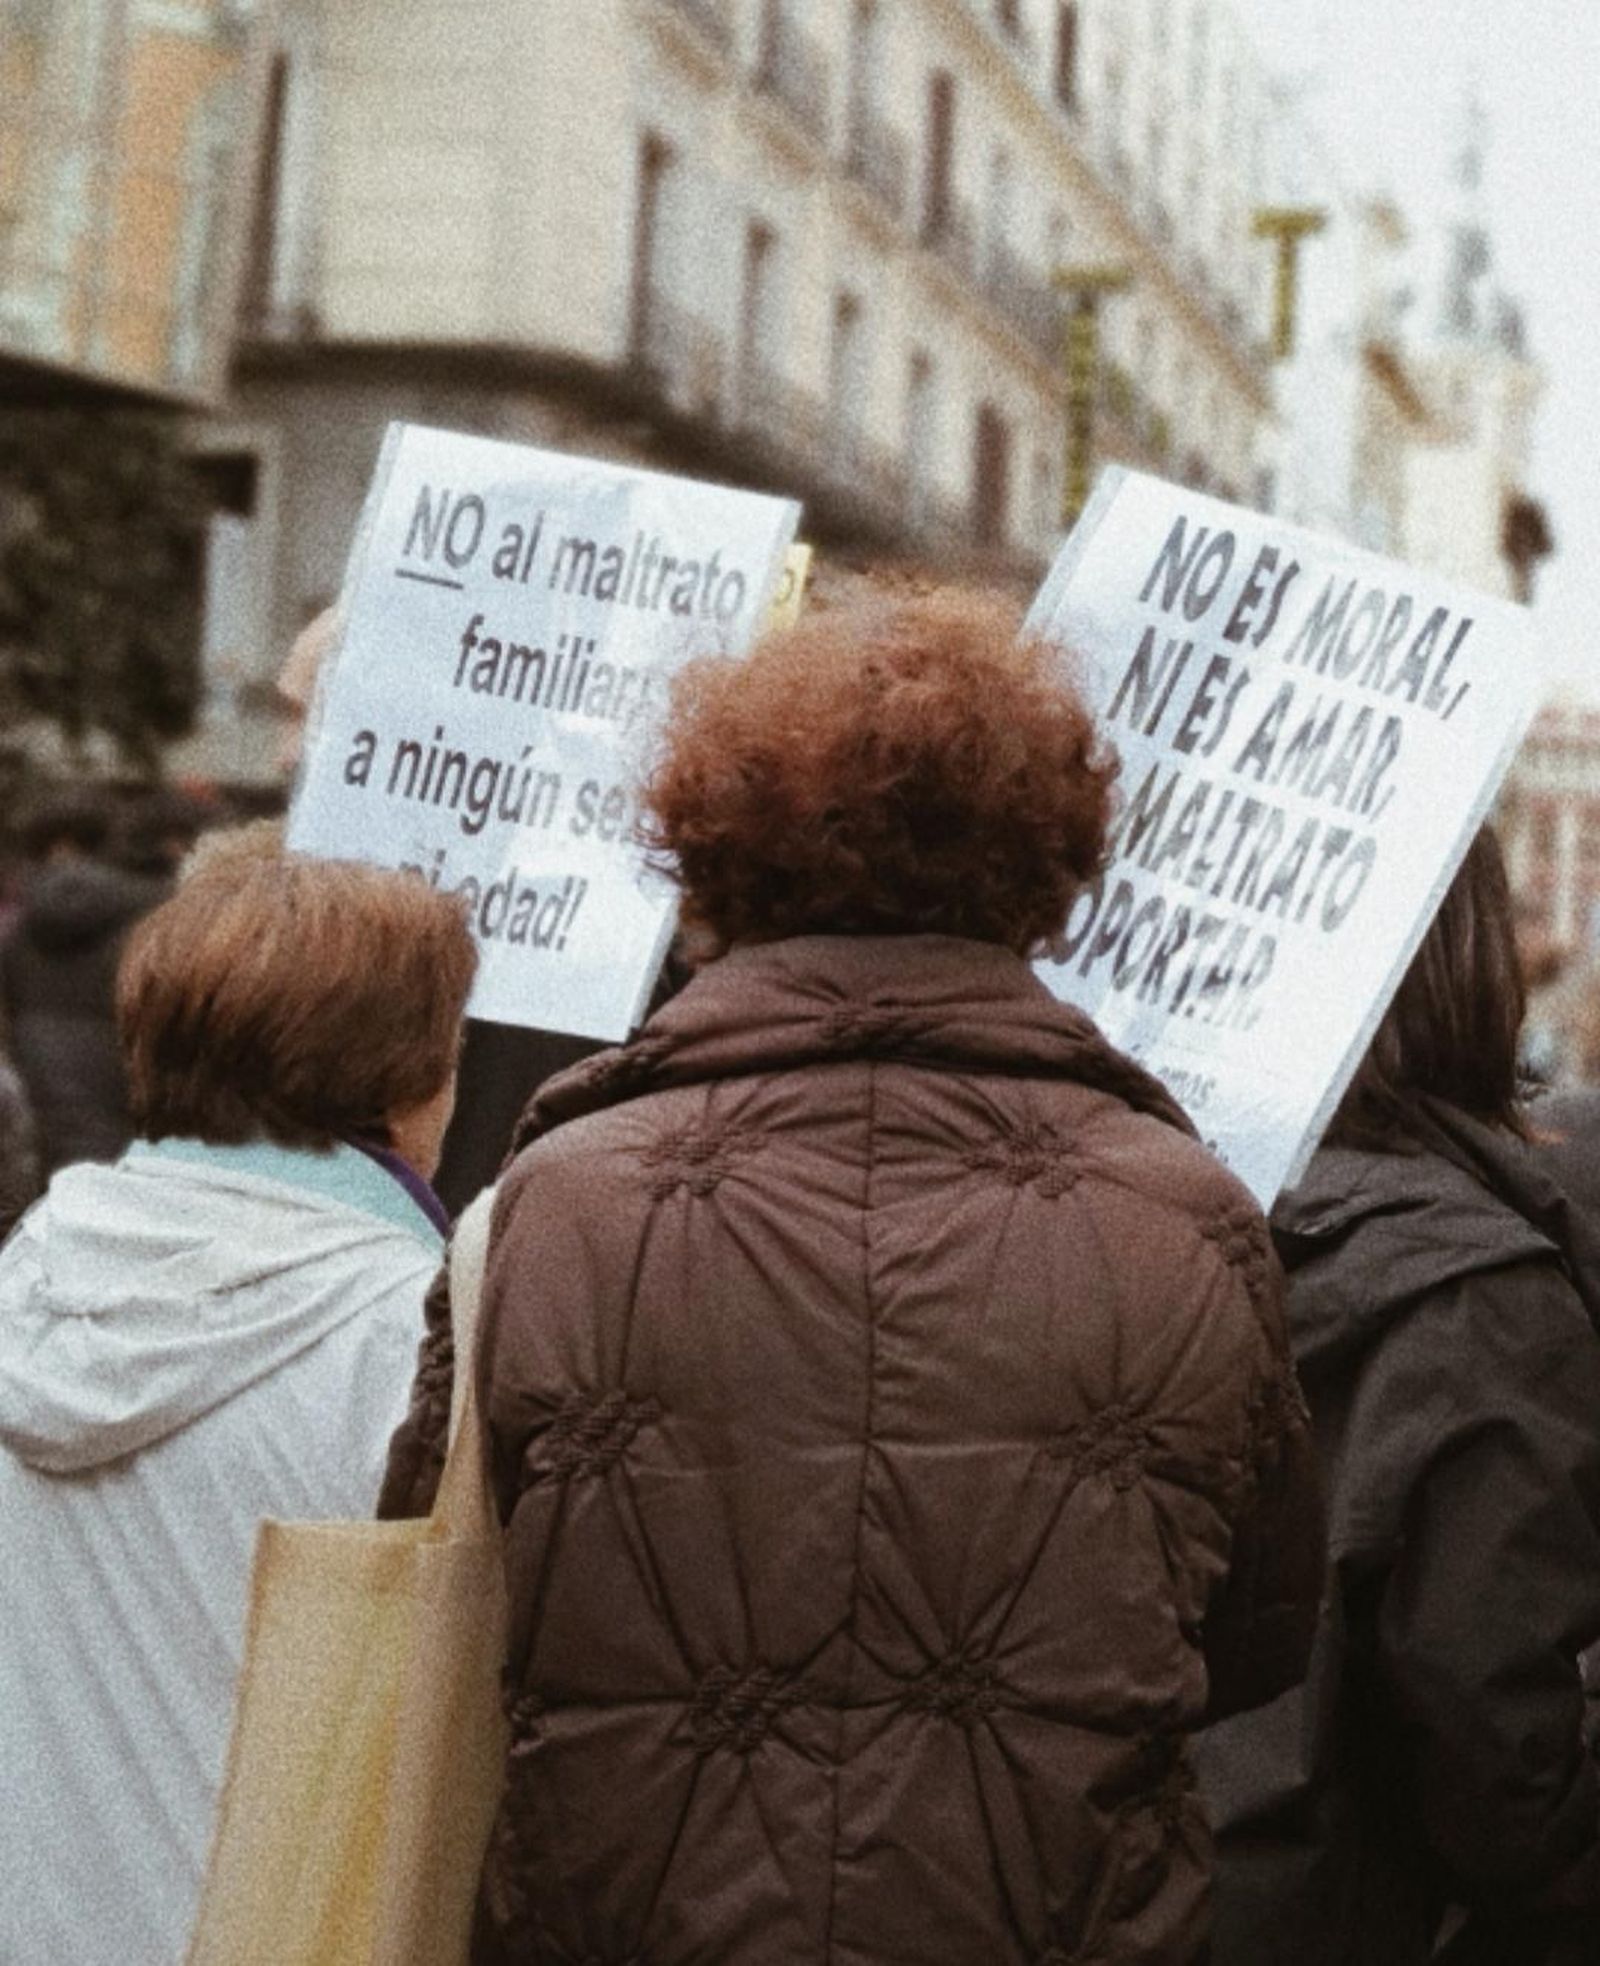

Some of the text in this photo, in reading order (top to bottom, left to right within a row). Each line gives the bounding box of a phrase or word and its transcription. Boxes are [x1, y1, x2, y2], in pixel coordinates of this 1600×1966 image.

[402, 485, 484, 569] NO
[491, 509, 544, 585] al
[548, 530, 745, 619] maltrato
[1139, 515, 1474, 720] NO ES MORAL,
[1106, 625, 1194, 736] NI
[1172, 653, 1251, 758] ES
[343, 725, 633, 842] a ningún se
[1107, 761, 1377, 934] MALTRATO
